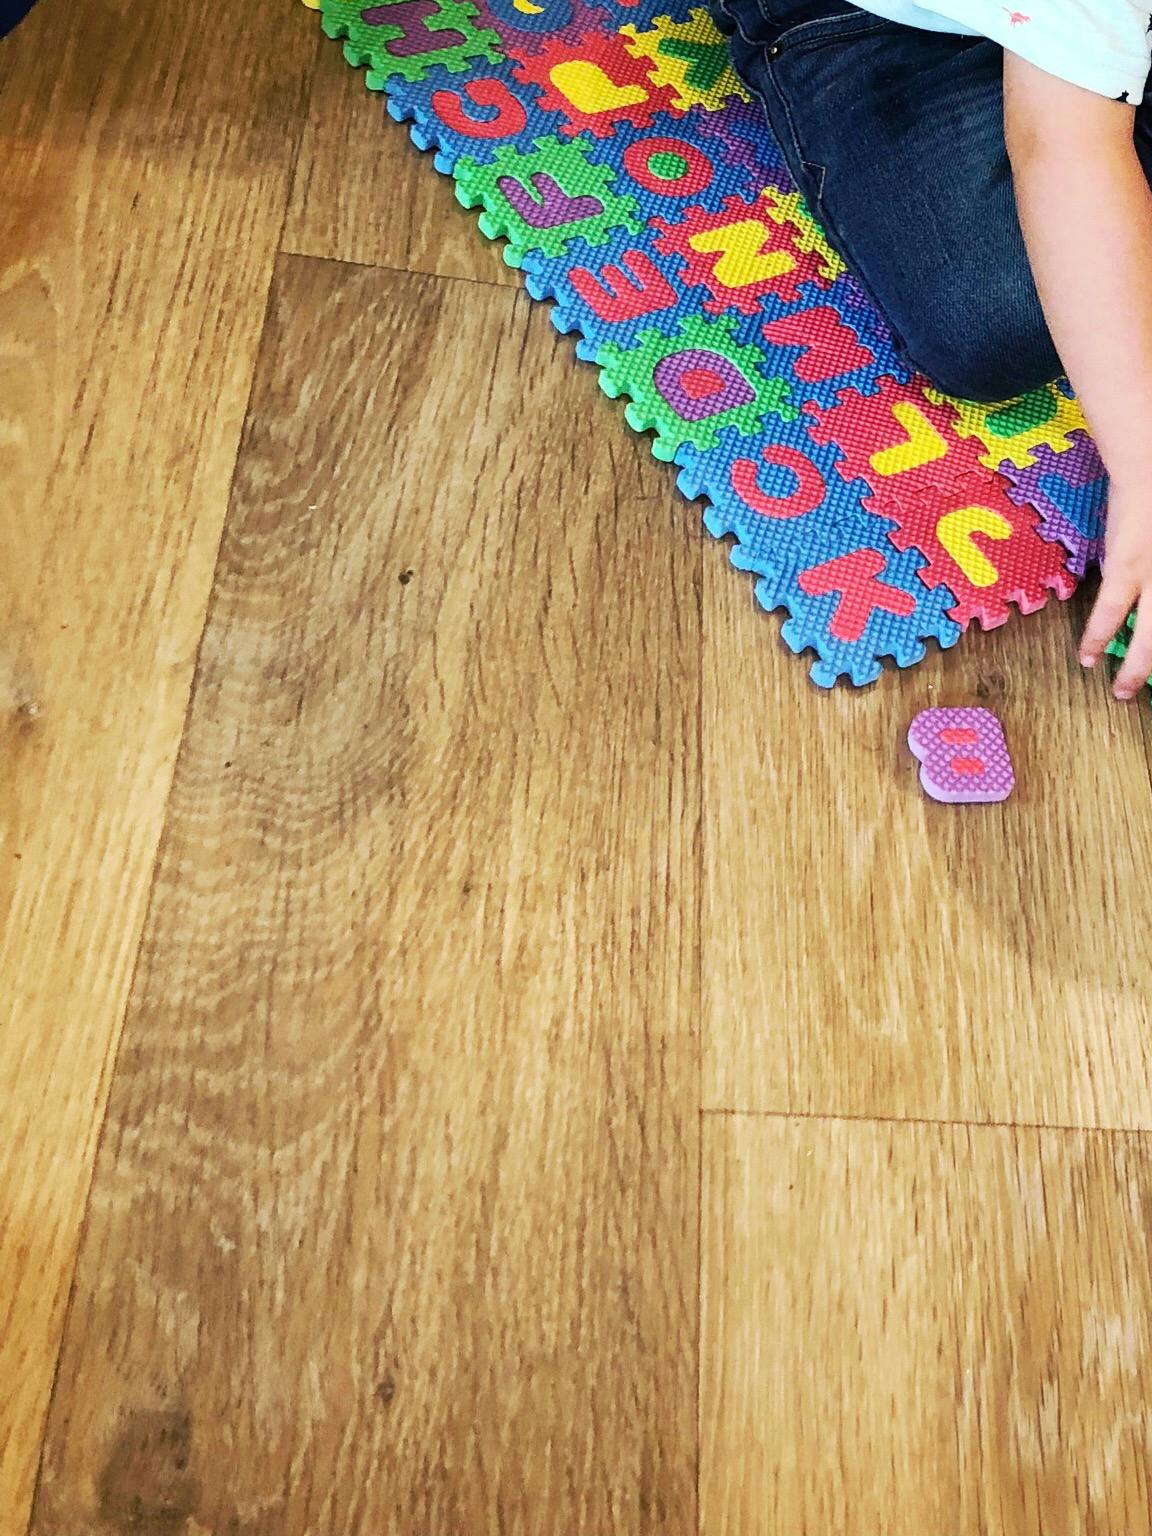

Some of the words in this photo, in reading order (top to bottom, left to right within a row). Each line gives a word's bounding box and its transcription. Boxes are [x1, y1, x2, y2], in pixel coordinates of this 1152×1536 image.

[362, 0, 466, 55] H
[431, 77, 526, 138] G
[551, 60, 648, 113] P
[499, 174, 603, 228] F
[568, 249, 677, 322] E
[690, 219, 796, 288] N
[763, 307, 873, 383] M
[653, 349, 755, 420] D
[869, 402, 947, 476] L
[731, 444, 826, 516] C
[800, 548, 916, 642] K
[908, 708, 1015, 803] B
